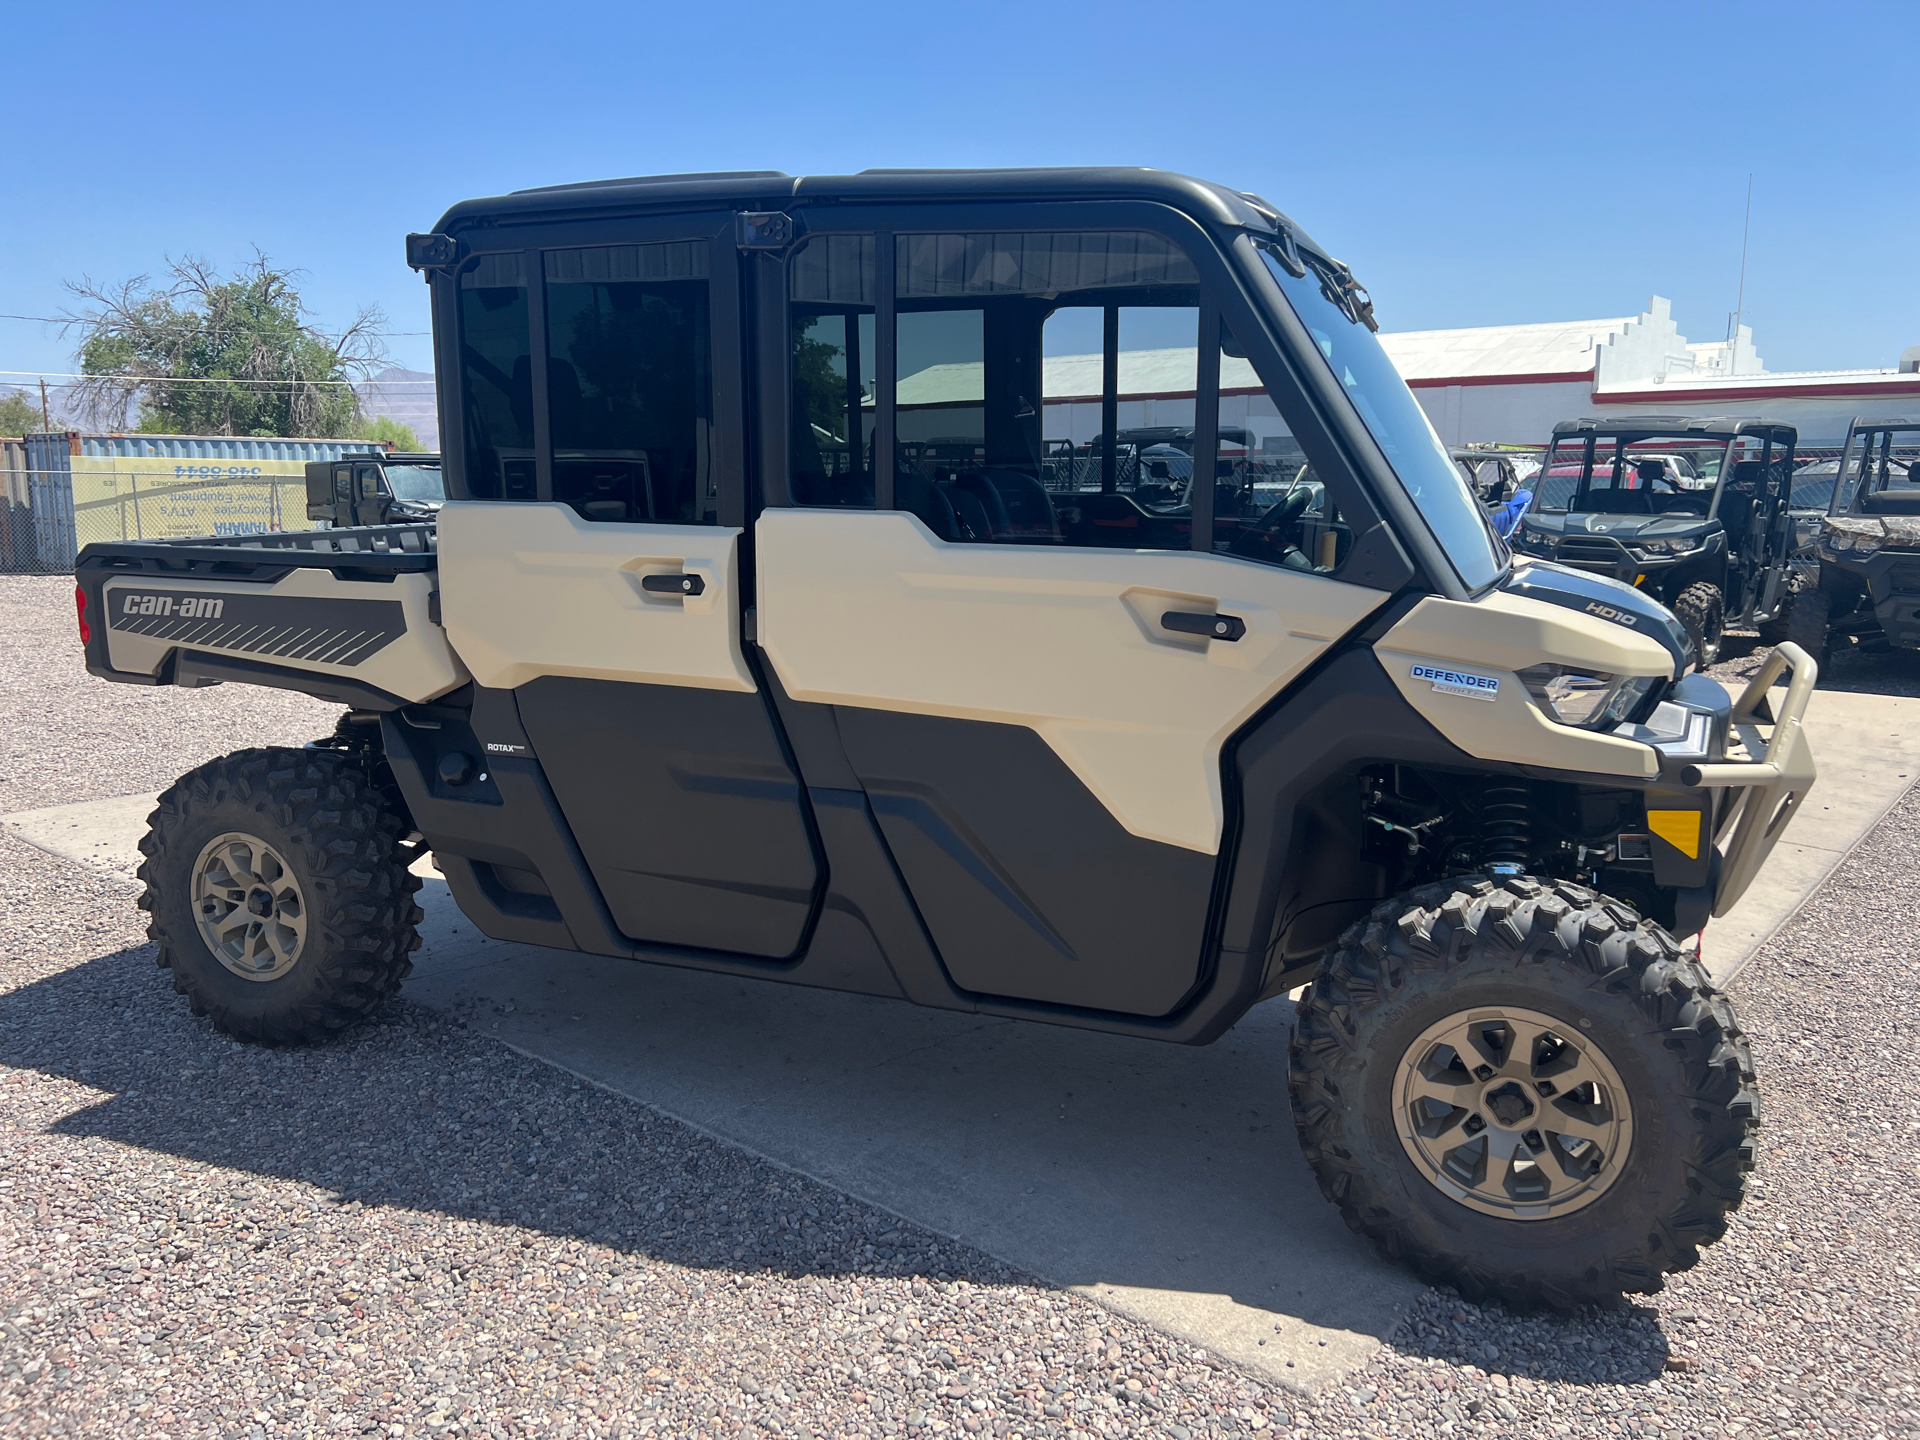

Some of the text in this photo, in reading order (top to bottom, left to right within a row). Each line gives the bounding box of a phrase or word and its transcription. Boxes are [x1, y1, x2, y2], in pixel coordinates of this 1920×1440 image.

[170, 491, 271, 503] Power Equipment
[213, 521, 268, 535] YAMAHA
[123, 595, 224, 619] can-am
[1585, 602, 1637, 625] HD10
[1413, 667, 1497, 690] DEFENDER
[487, 743, 514, 752] ROTAX
